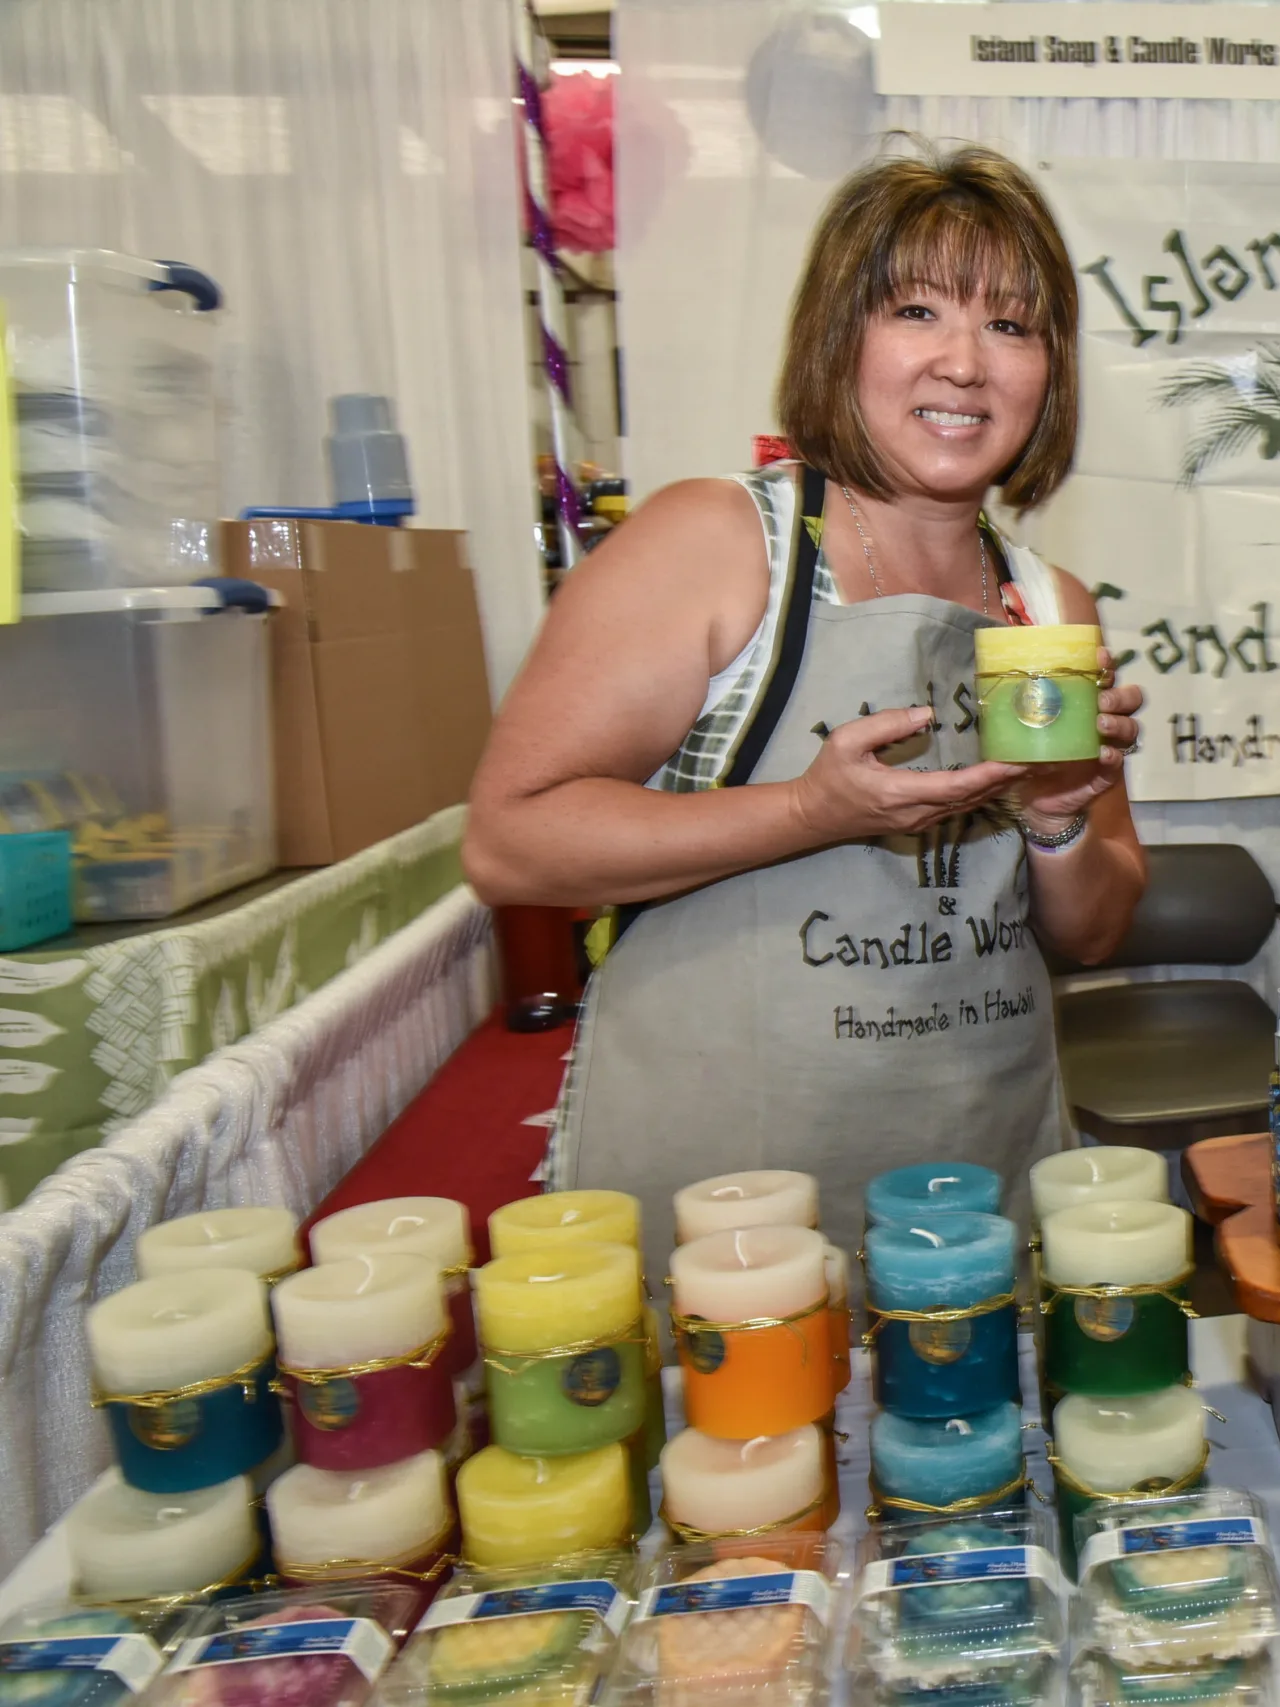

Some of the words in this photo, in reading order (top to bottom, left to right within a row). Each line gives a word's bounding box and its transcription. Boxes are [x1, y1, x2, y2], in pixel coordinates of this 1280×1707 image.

[970, 35, 1038, 62] Island
[1043, 36, 1097, 67] Soap
[1104, 36, 1123, 62] &
[1127, 36, 1202, 63] Candle
[1204, 38, 1279, 66] Works
[938, 896, 957, 916] &
[799, 910, 953, 969] Candle
[965, 901, 1025, 958] Wor
[833, 1003, 950, 1041] Handmade
[959, 999, 979, 1026] in
[984, 986, 1036, 1024] Hawaii
